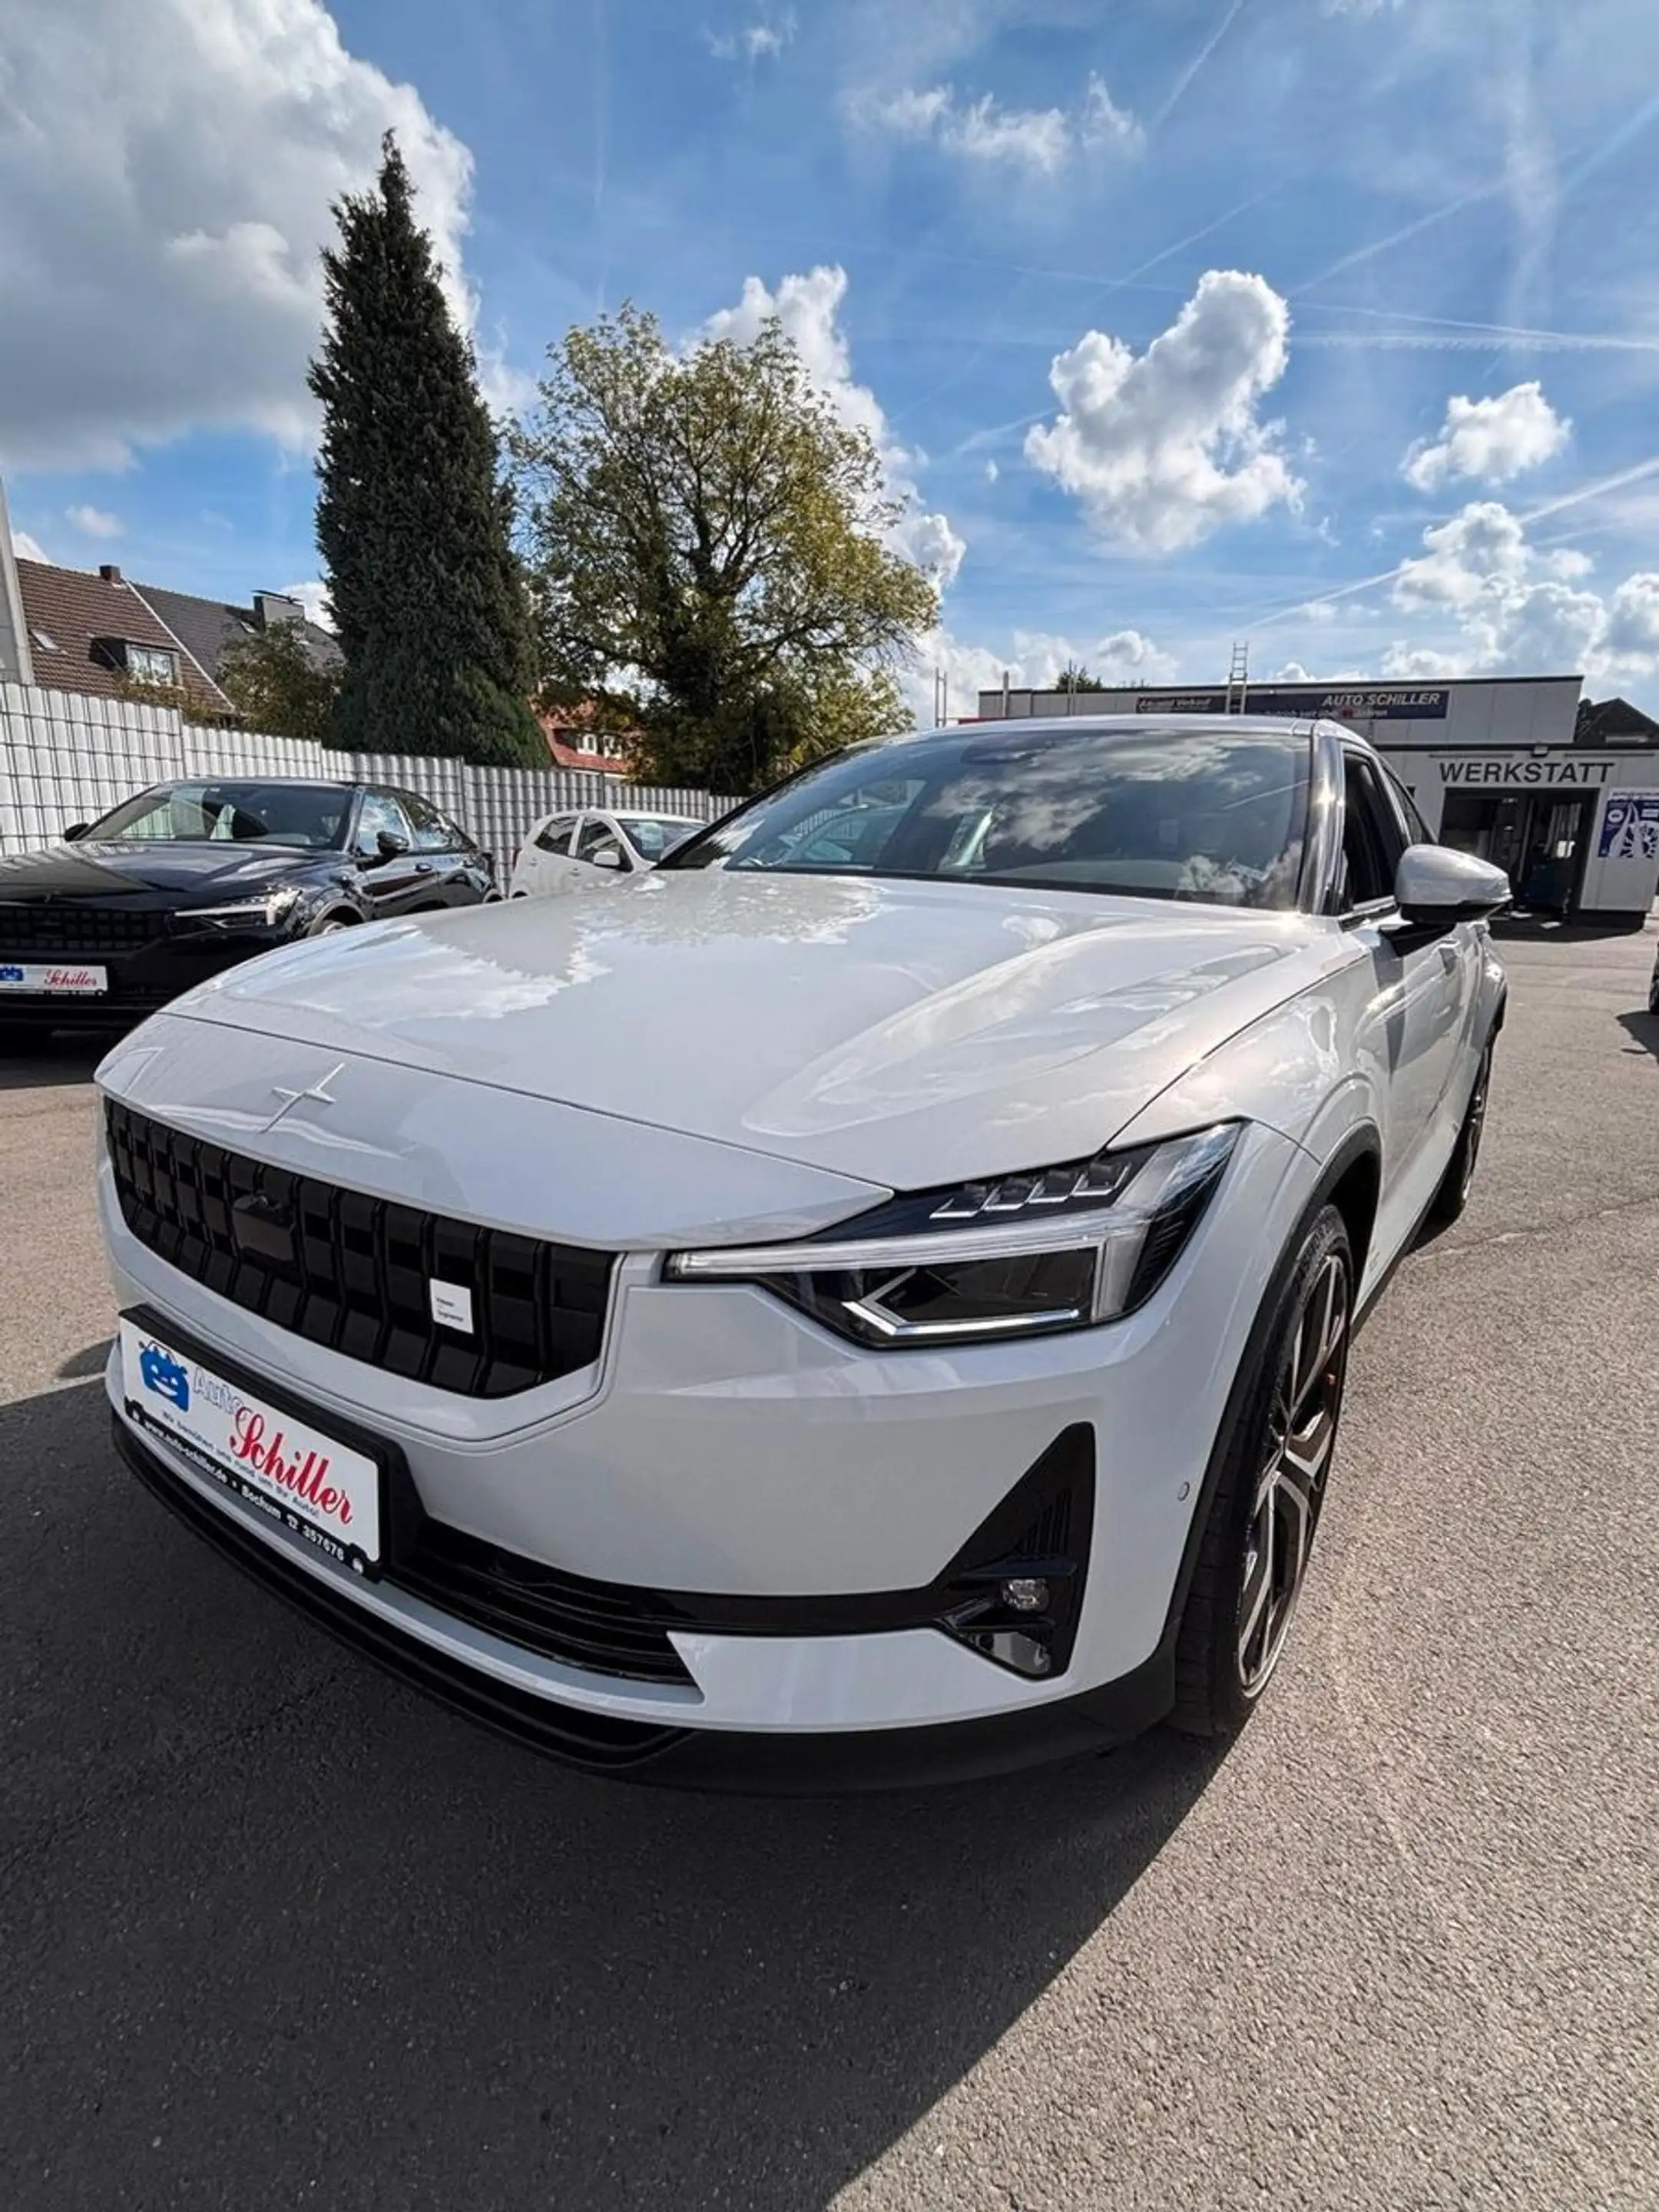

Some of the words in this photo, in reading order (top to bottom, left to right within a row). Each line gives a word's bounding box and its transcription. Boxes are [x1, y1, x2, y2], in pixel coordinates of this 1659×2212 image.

[1321, 694, 1363, 707] AUTO
[1367, 693, 1441, 706] SCHILLER
[1439, 762, 1616, 783] WERKSTATT
[45, 969, 97, 986] Schiller
[193, 1366, 245, 1419] Auto
[230, 1406, 353, 1525] Schiller
[240, 1484, 282, 1520] Bochum
